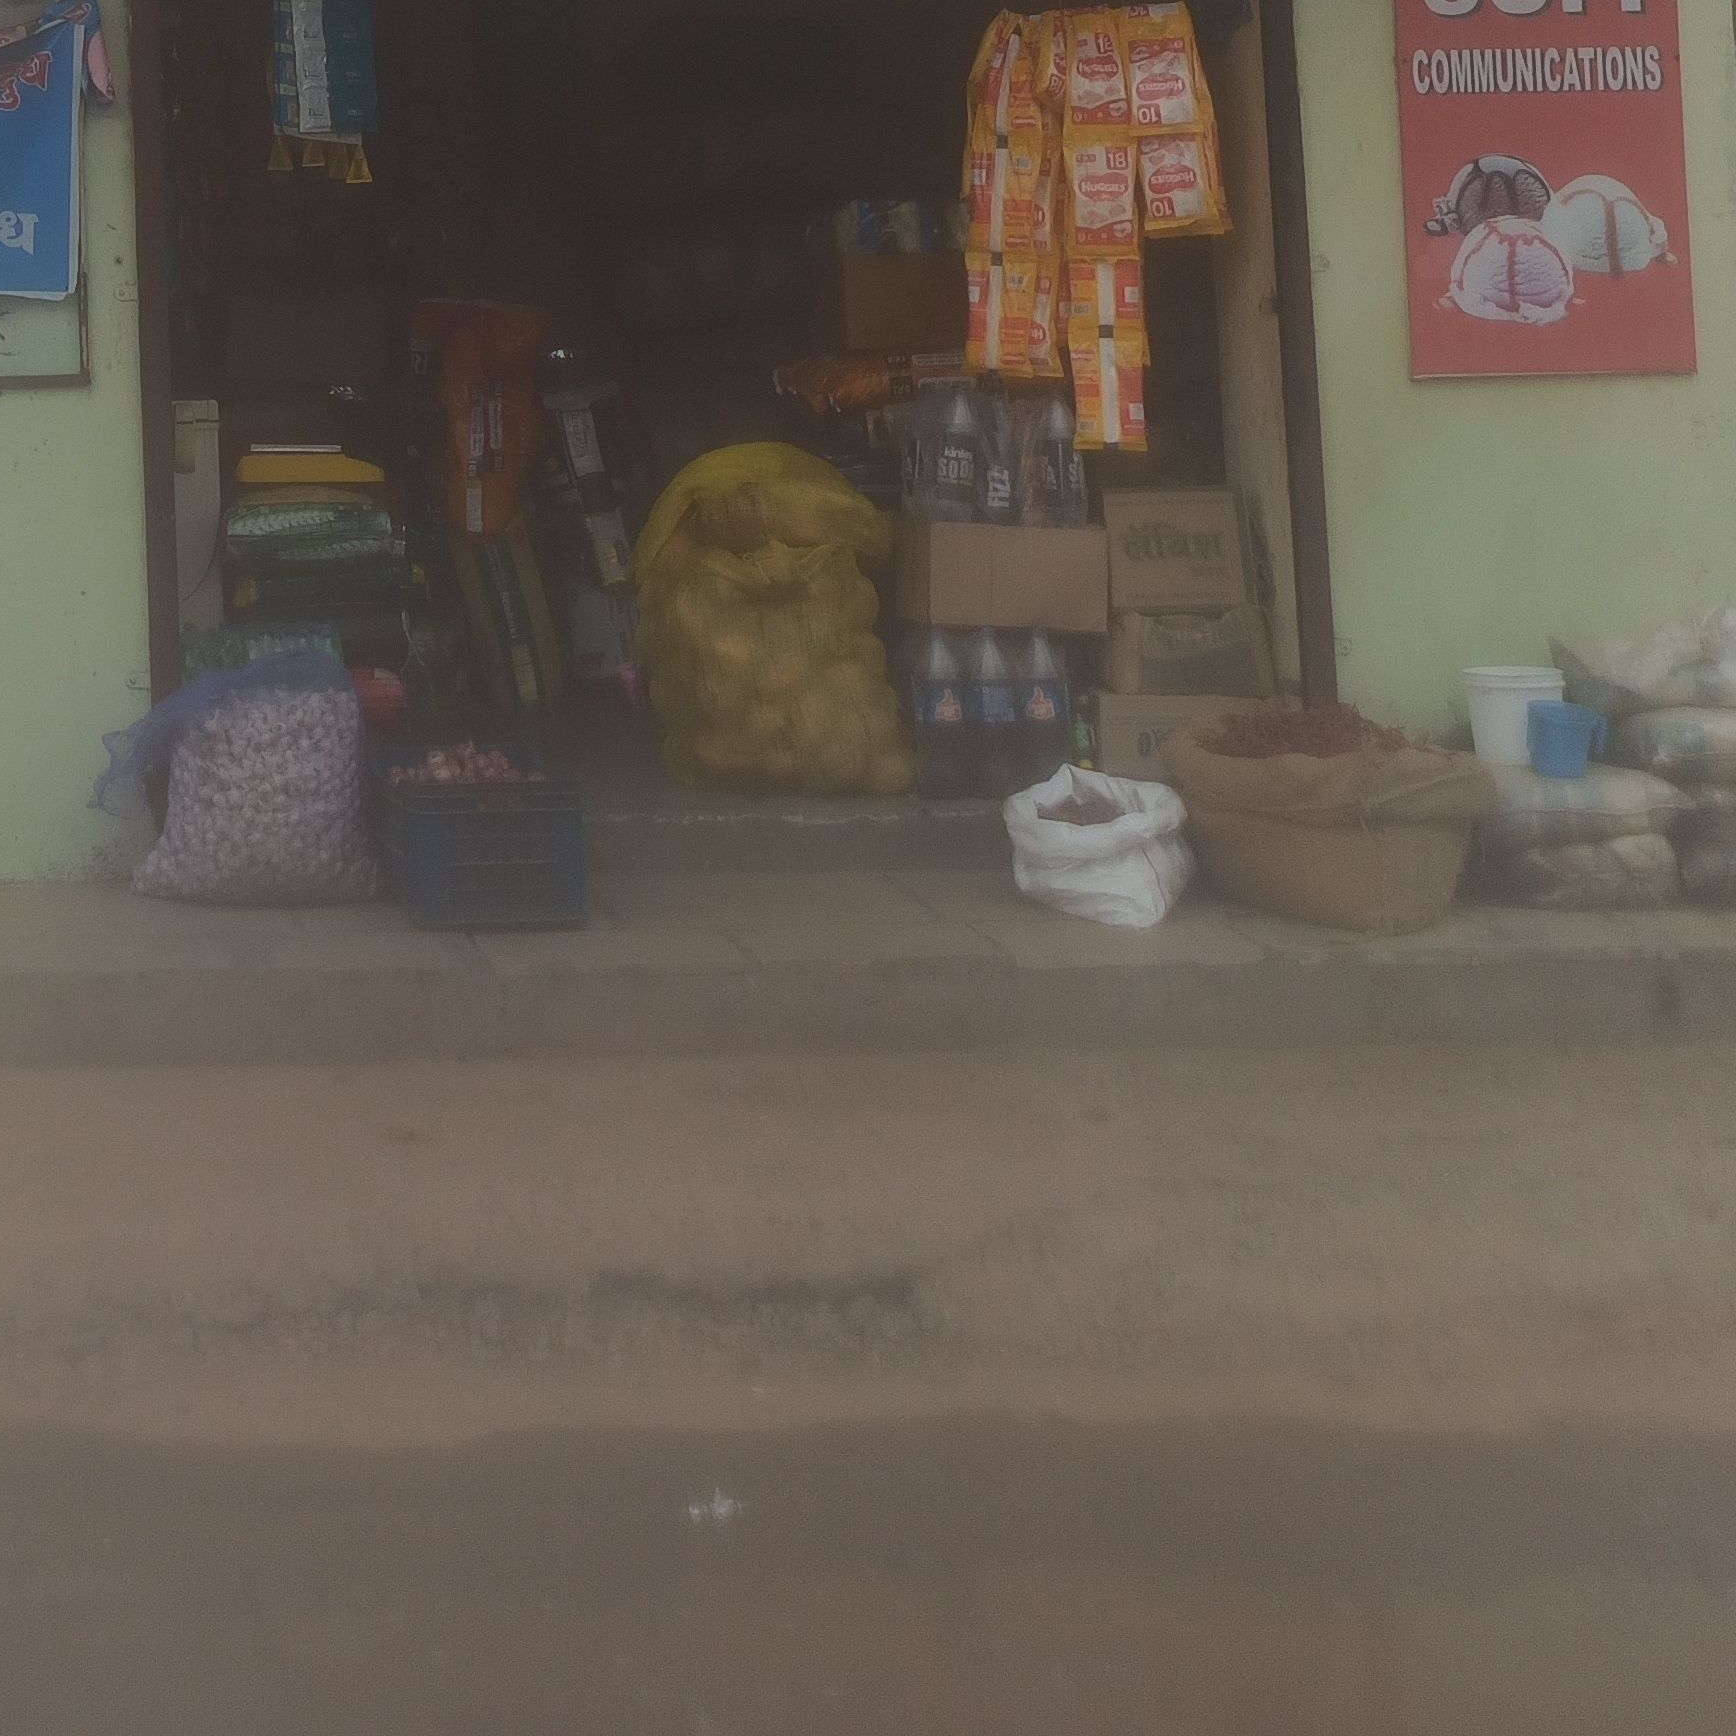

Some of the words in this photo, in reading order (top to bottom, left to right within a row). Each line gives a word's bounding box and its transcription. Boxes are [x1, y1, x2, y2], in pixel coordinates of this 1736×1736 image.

[1412, 47, 1662, 93] COMMUNICATIONS
[1108, 151, 1128, 169] 18
[1152, 199, 1174, 217] 10
